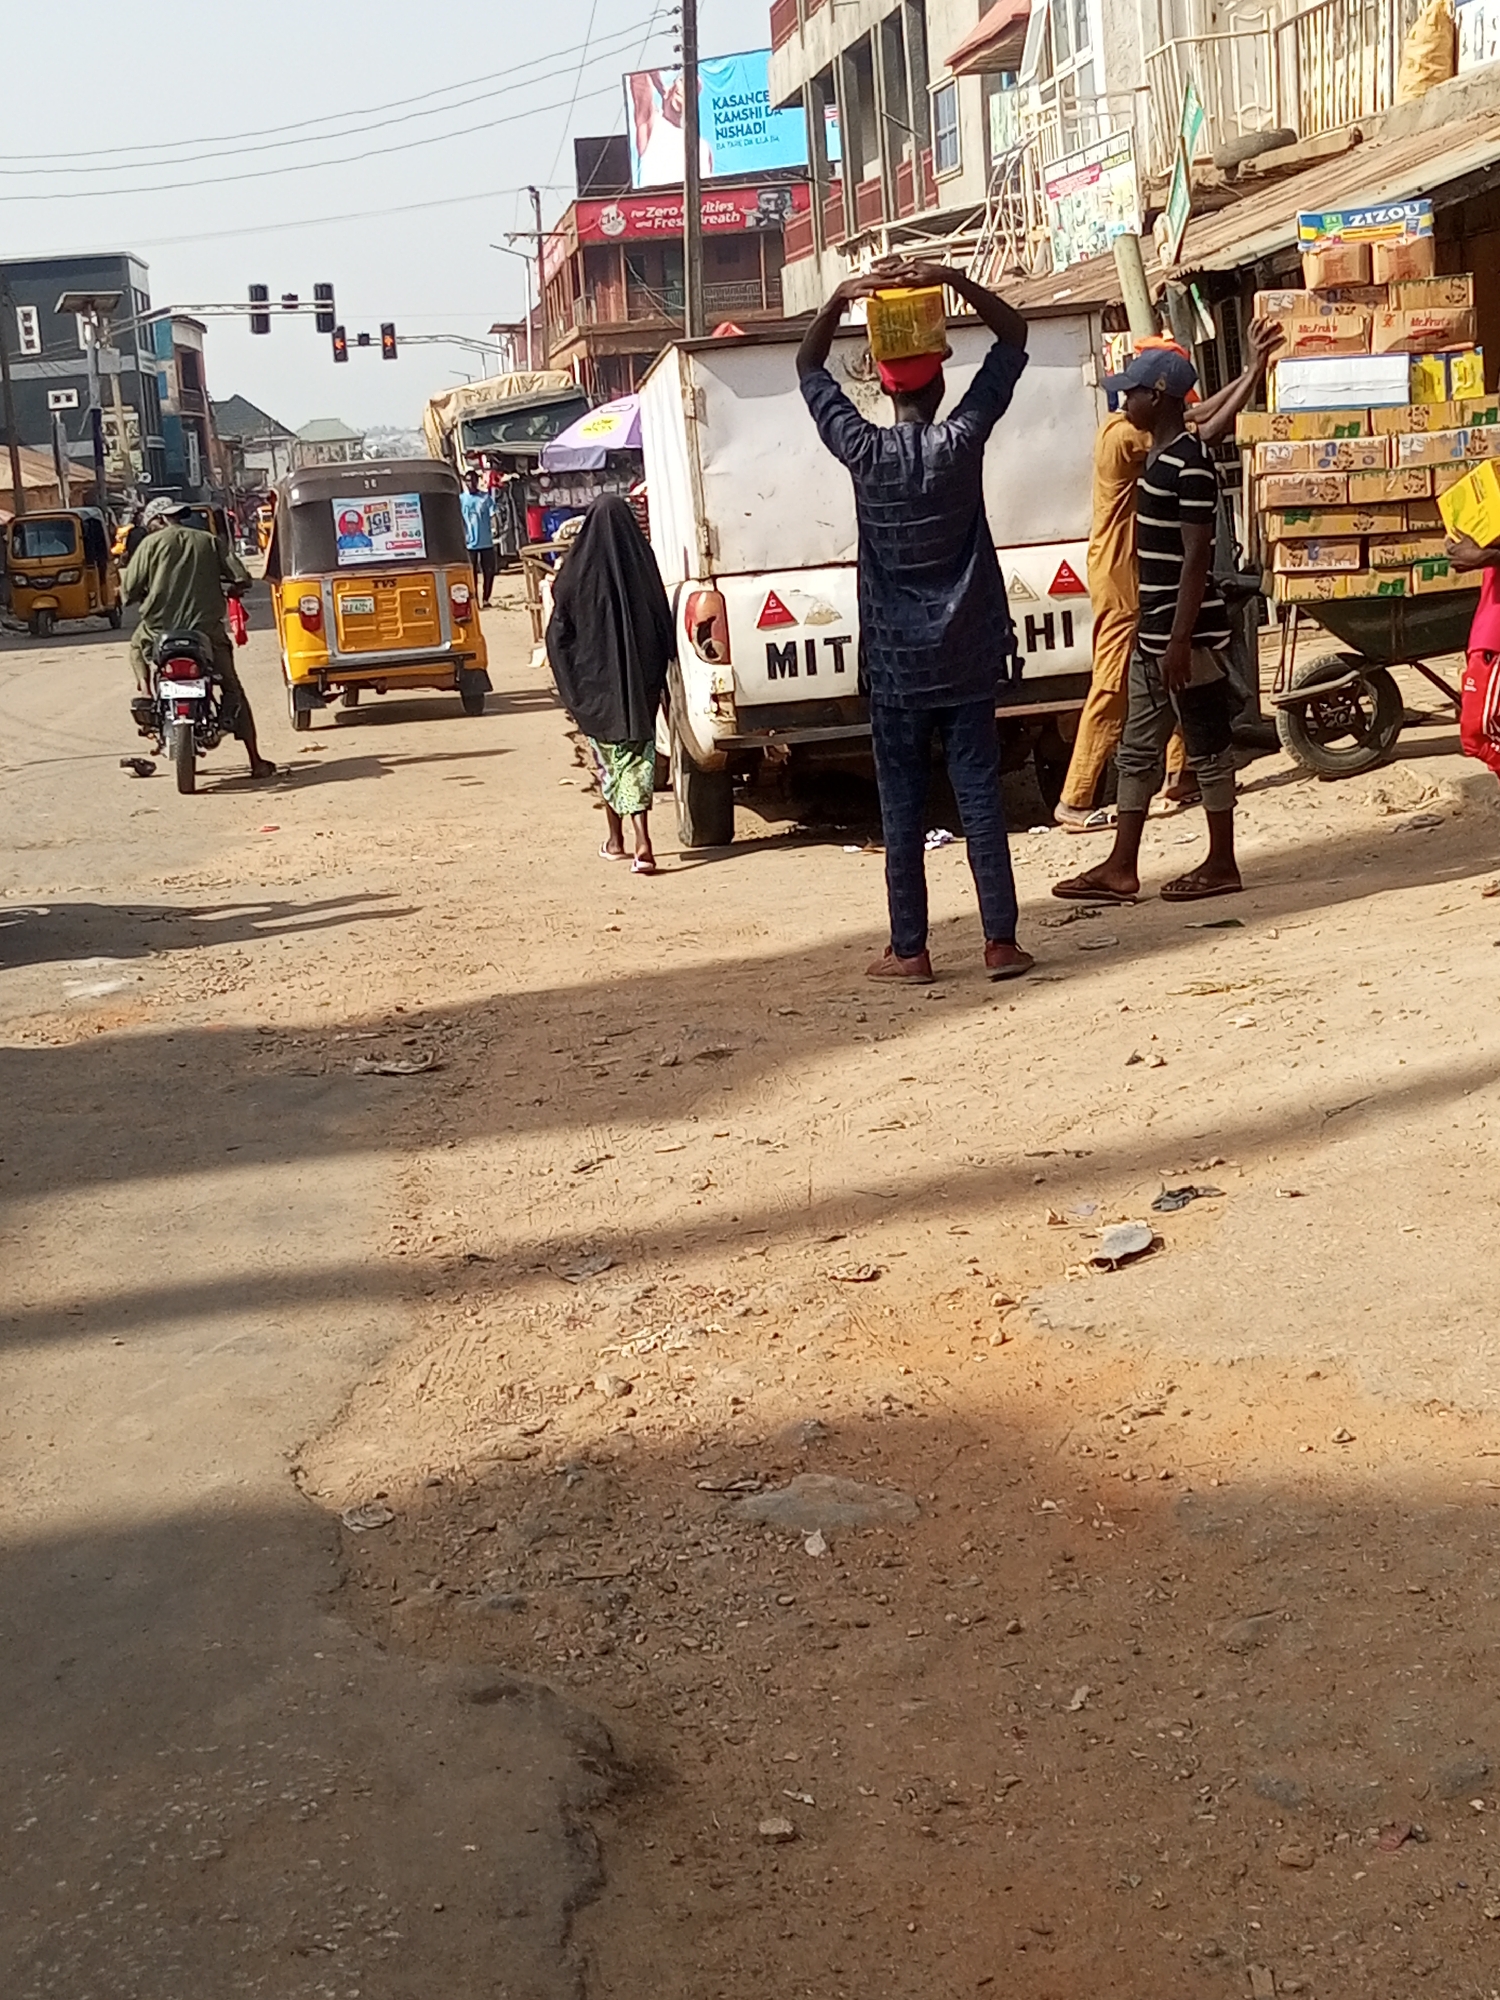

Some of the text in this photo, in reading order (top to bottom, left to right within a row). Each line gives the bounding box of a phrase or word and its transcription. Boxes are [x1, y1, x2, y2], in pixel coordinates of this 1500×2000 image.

[714, 106, 762, 126] KAMSHI
[715, 120, 766, 140] NISHADI
[646, 206, 678, 218] Zero
[654, 217, 684, 229] Fres
[701, 211, 741, 225] reath
[1349, 203, 1420, 227] ZIZOU
[372, 578, 397, 589] TVS
